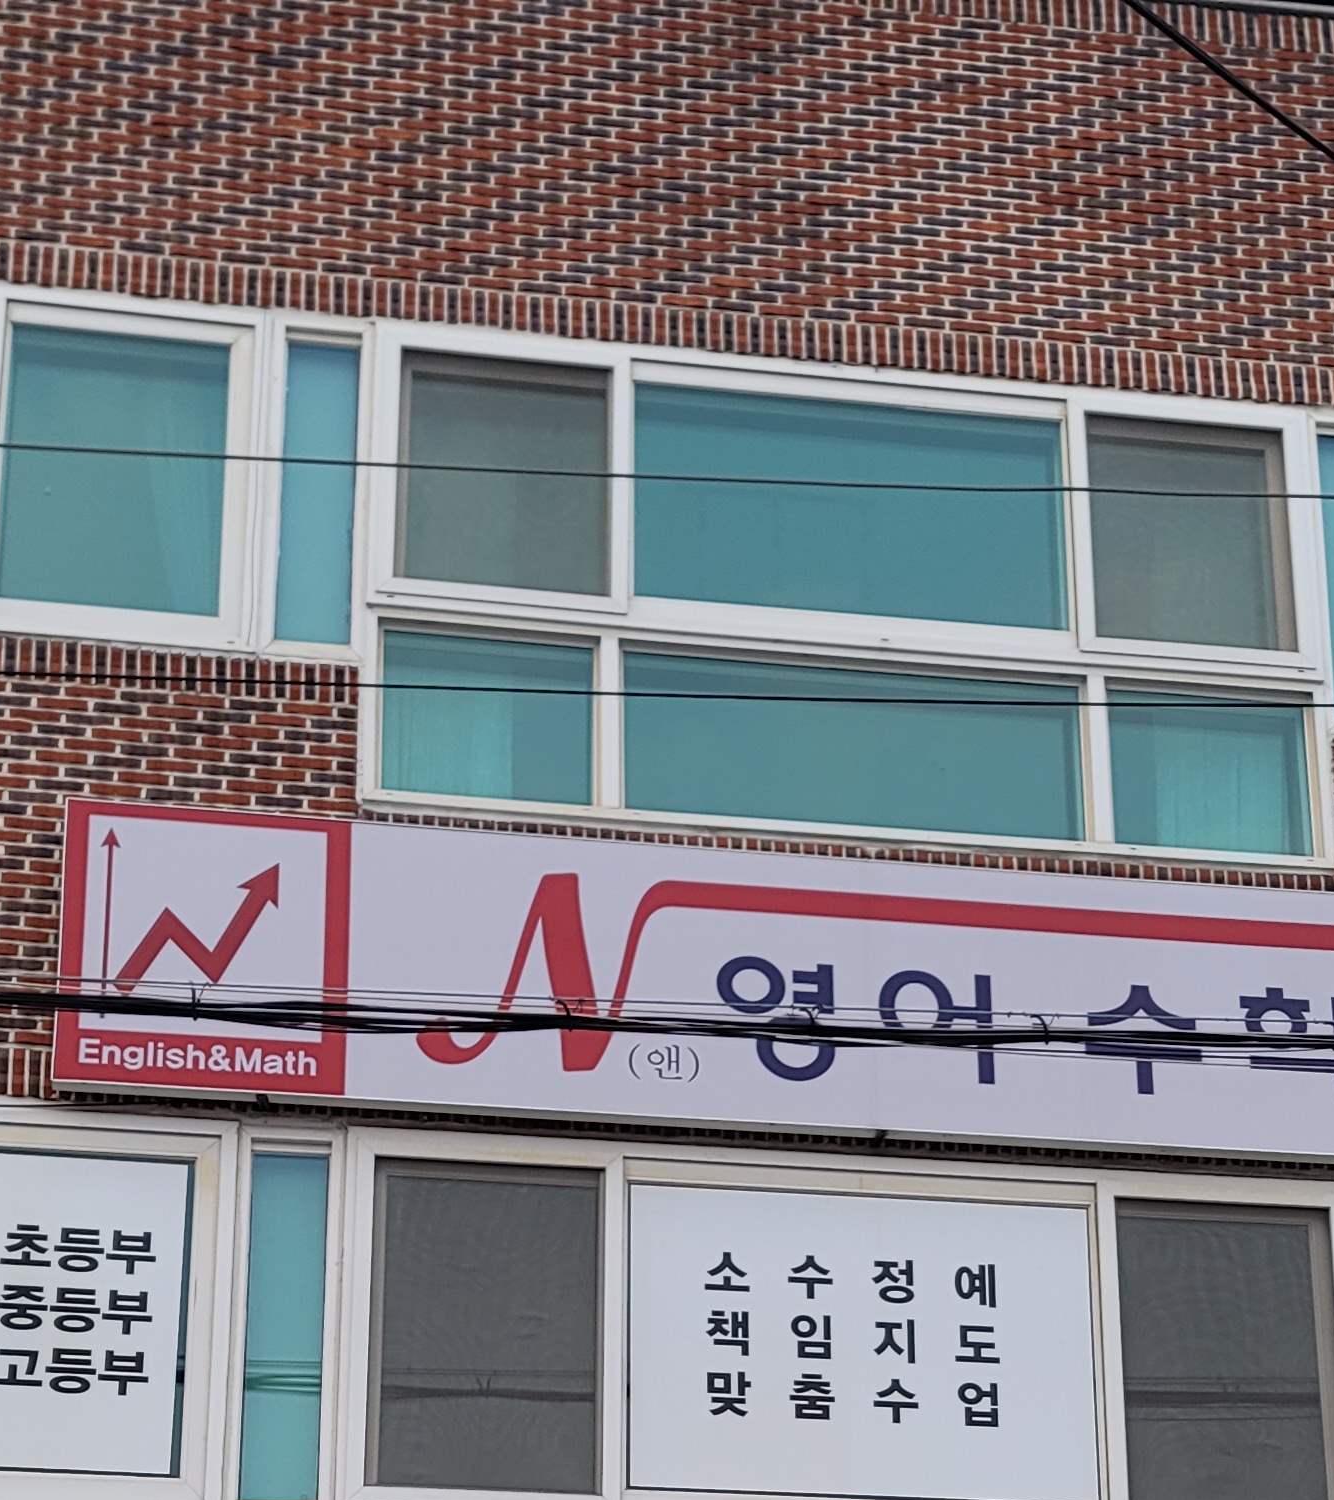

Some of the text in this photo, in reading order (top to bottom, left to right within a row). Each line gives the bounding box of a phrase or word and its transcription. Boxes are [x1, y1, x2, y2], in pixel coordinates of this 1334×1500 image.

[77, 1037, 318, 1078] English&Math
[628, 1043, 701, 1083] (앤)
[0, 1223, 157, 1275] 초등부
